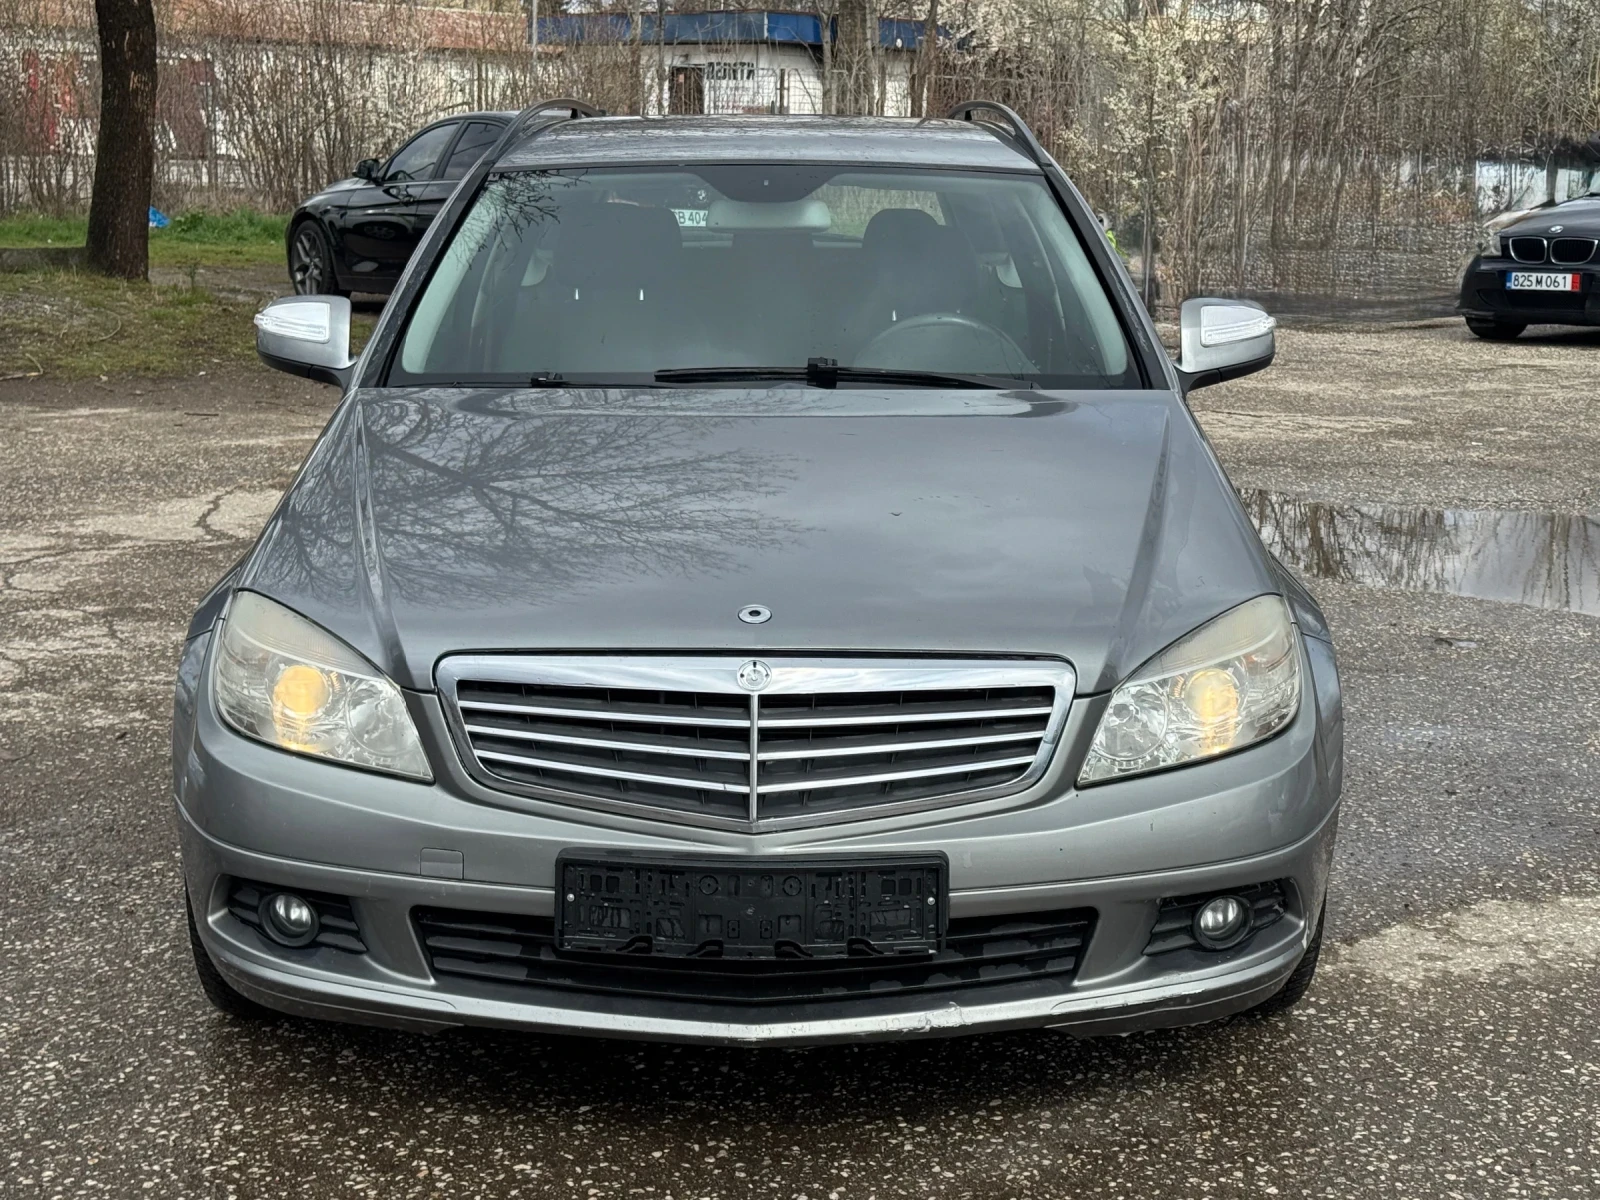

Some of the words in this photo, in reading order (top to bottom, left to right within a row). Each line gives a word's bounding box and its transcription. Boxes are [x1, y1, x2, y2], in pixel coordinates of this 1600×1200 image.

[1513, 274, 1533, 287] 825
[1535, 275, 1543, 288] M
[1545, 275, 1567, 288] 061
